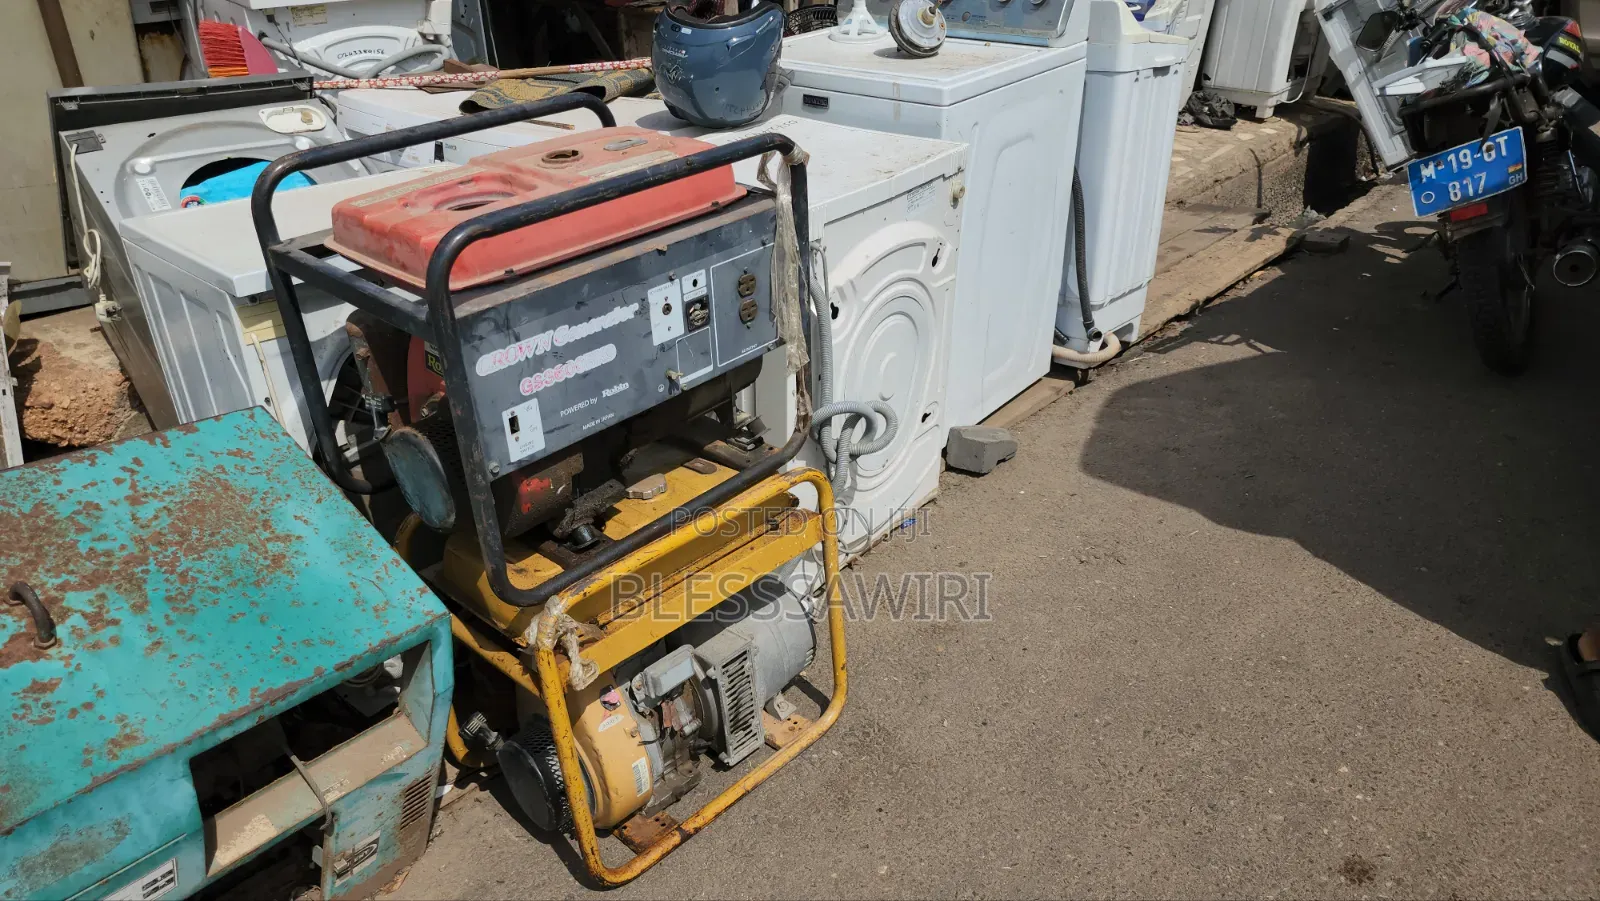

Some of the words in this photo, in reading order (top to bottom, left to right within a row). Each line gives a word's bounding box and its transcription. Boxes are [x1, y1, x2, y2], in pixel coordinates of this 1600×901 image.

[1448, 171, 1487, 202] 817
[1508, 174, 1523, 185] GH
[560, 399, 590, 417] POWERED
[590, 396, 598, 405] by
[601, 382, 630, 398] Robin
[582, 421, 596, 431] MADE
[601, 412, 615, 423] JAPAN
